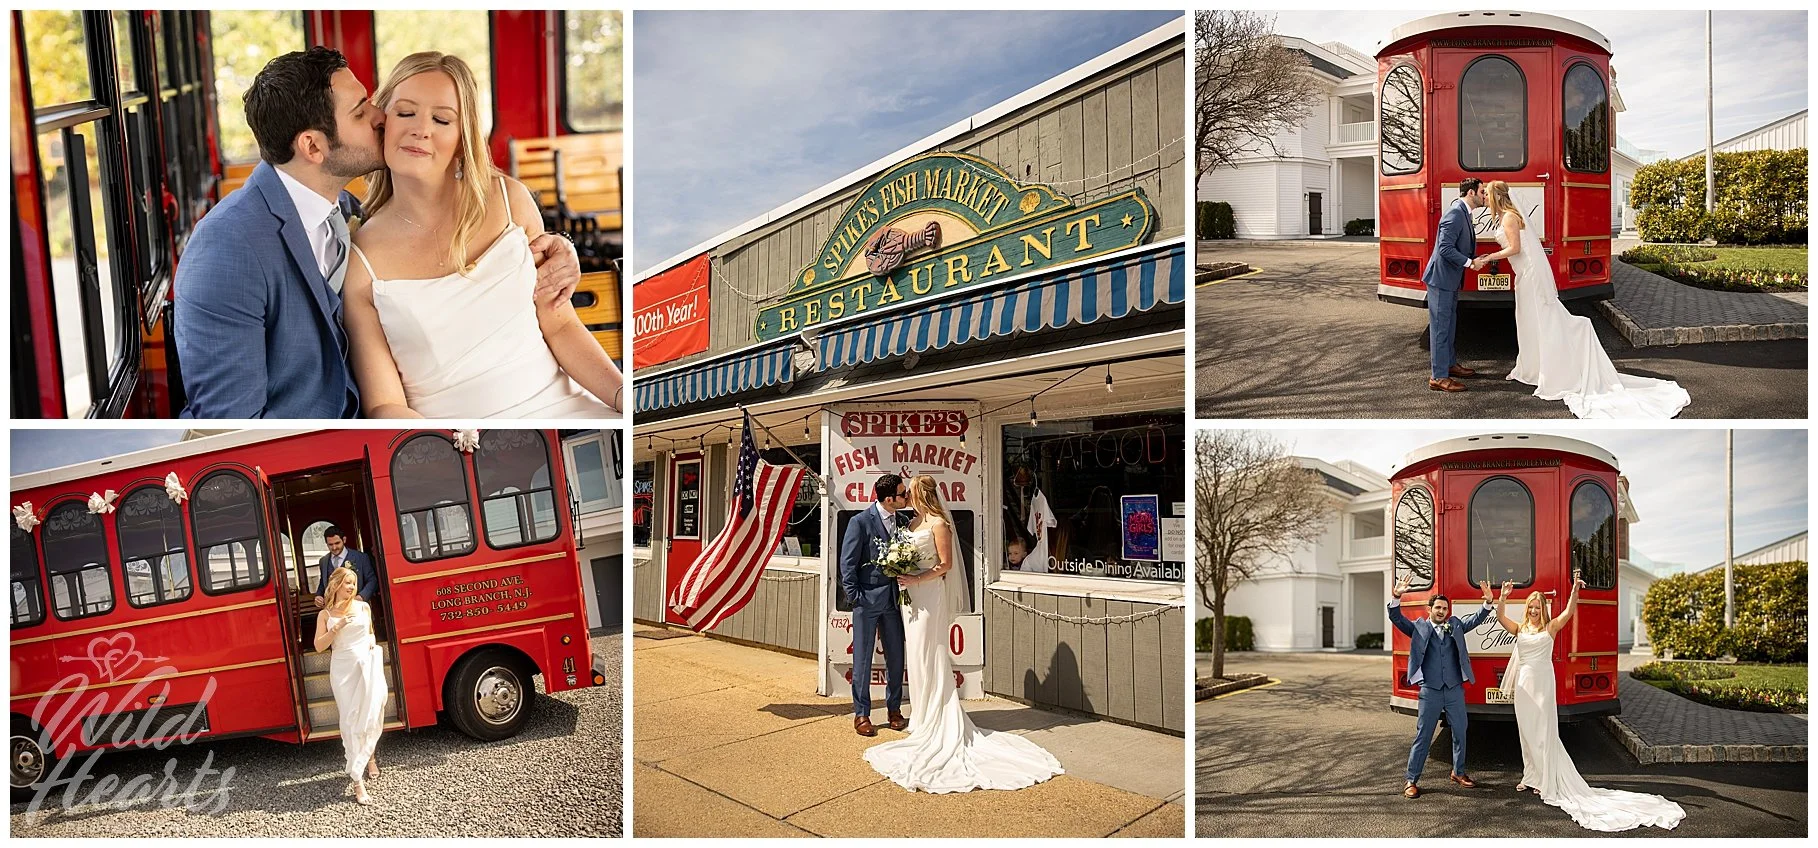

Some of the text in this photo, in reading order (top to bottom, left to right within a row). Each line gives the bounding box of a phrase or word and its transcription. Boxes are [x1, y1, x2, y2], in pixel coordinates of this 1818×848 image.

[823, 167, 1010, 276] SPIKE'S FISH MARKET
[1584, 240, 1591, 255] 41
[779, 213, 1101, 333] RESTAURANT
[666, 294, 698, 327] Year!
[848, 412, 962, 434] SPIKE'S
[834, 442, 978, 477] FISH MARKET
[899, 464, 914, 480] &
[1129, 523, 1153, 533] GIRLS
[1047, 555, 1185, 580] Outside Dining Availabl
[436, 575, 524, 596] 608 SECOND AVE.
[431, 587, 533, 610] LONG BRANCH, N.J.
[496, 601, 527, 613] 5449
[831, 618, 850, 628] (732)
[563, 657, 576, 673] 41
